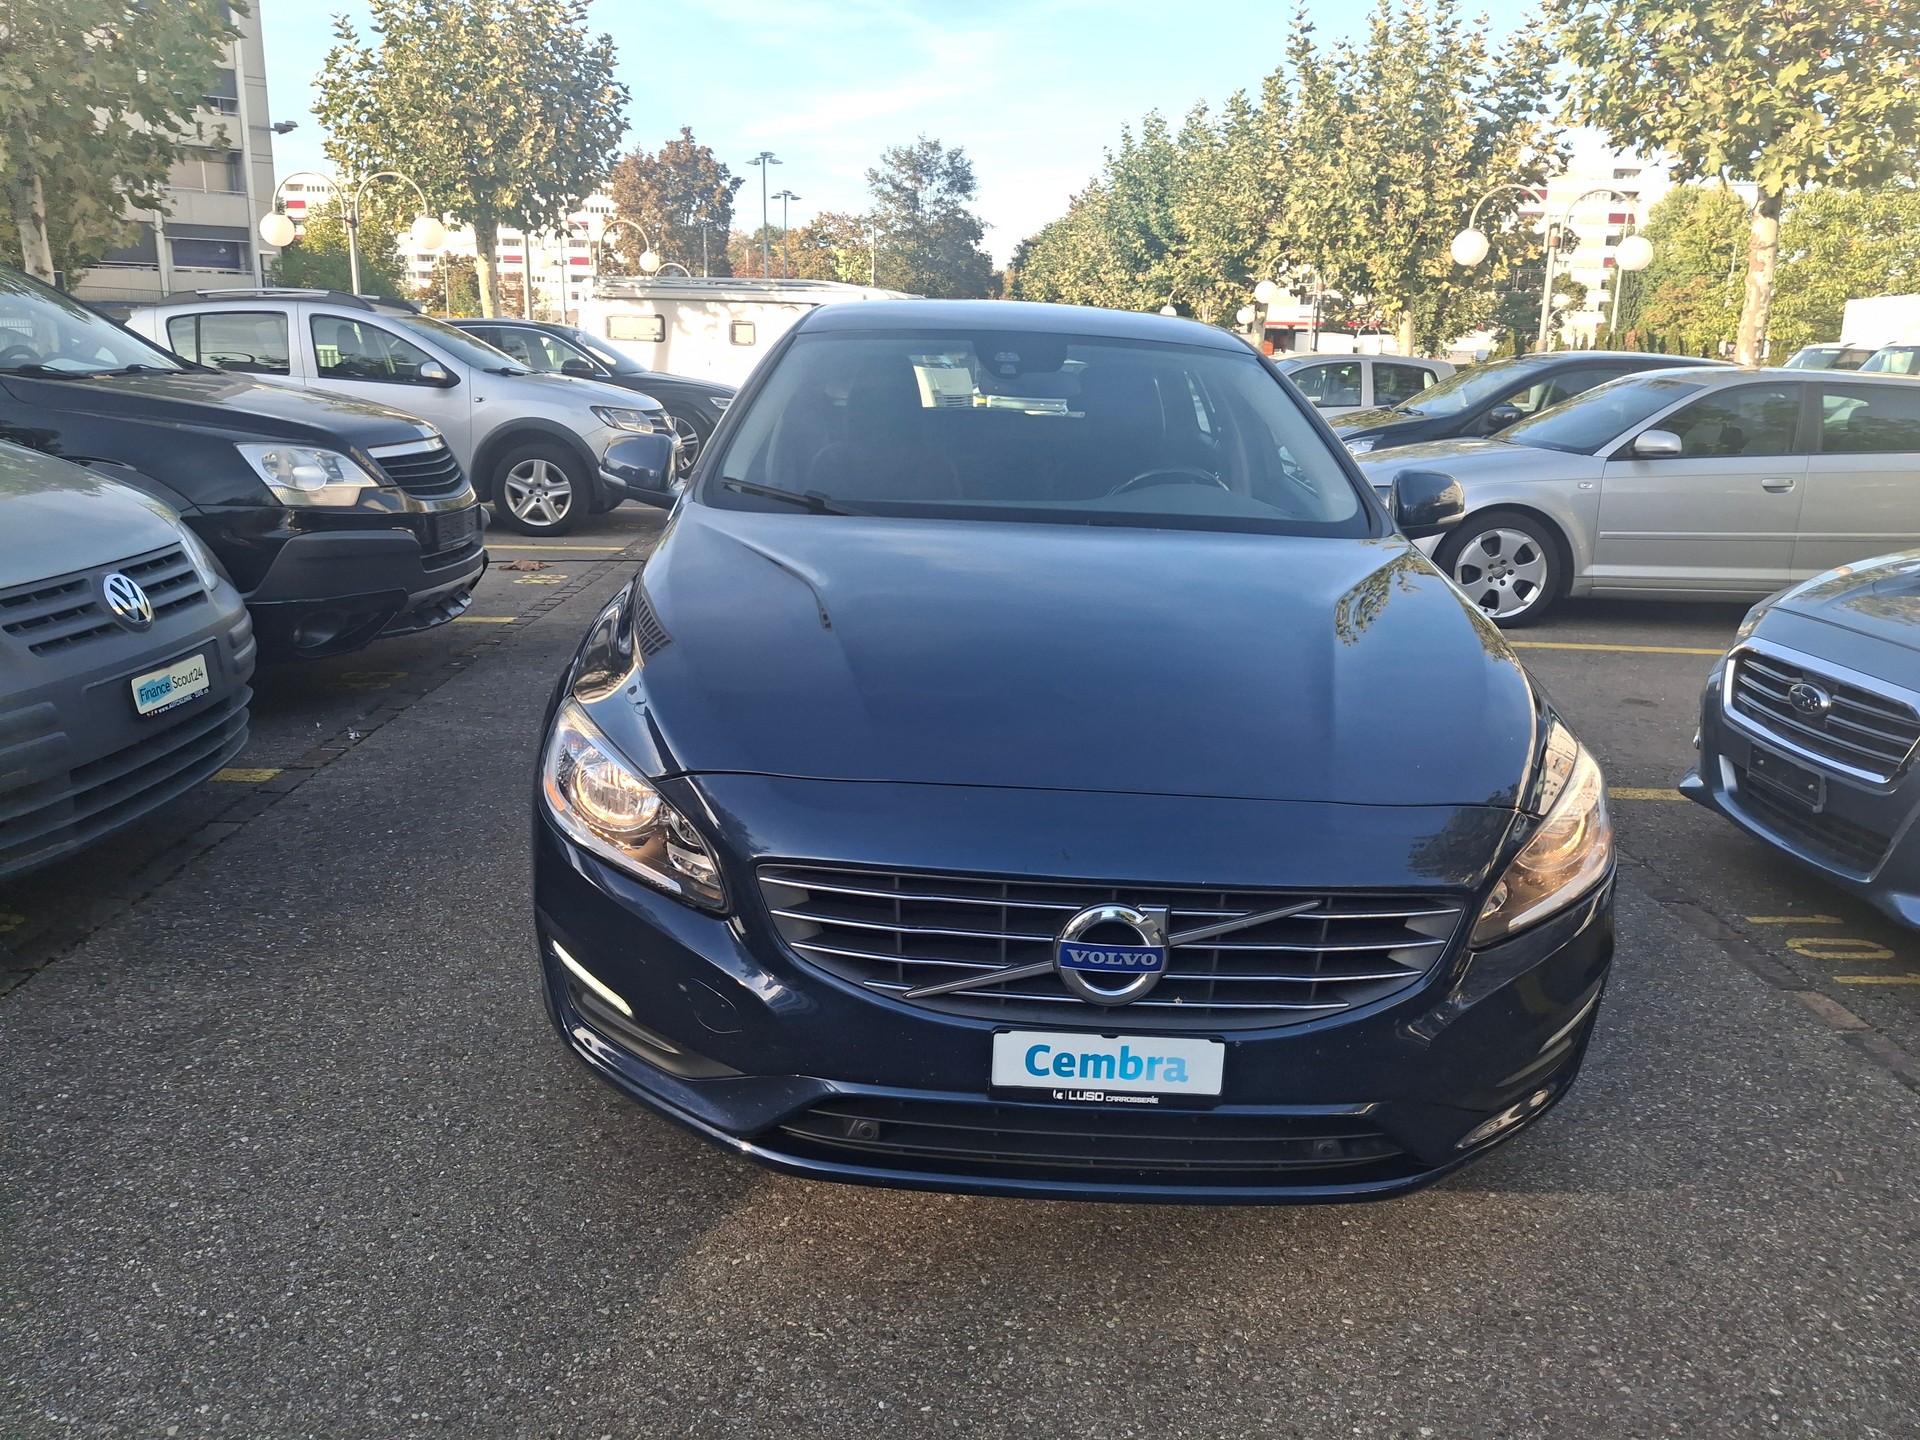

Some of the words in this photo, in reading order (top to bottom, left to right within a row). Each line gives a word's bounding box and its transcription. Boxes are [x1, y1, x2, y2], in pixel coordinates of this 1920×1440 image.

[139, 681, 171, 703] Finance
[172, 667, 204, 689] Scout24
[1067, 949, 1158, 966] VOLVO
[1024, 1044, 1189, 1083] Cembra
[1068, 1090, 1104, 1102] LUSO
